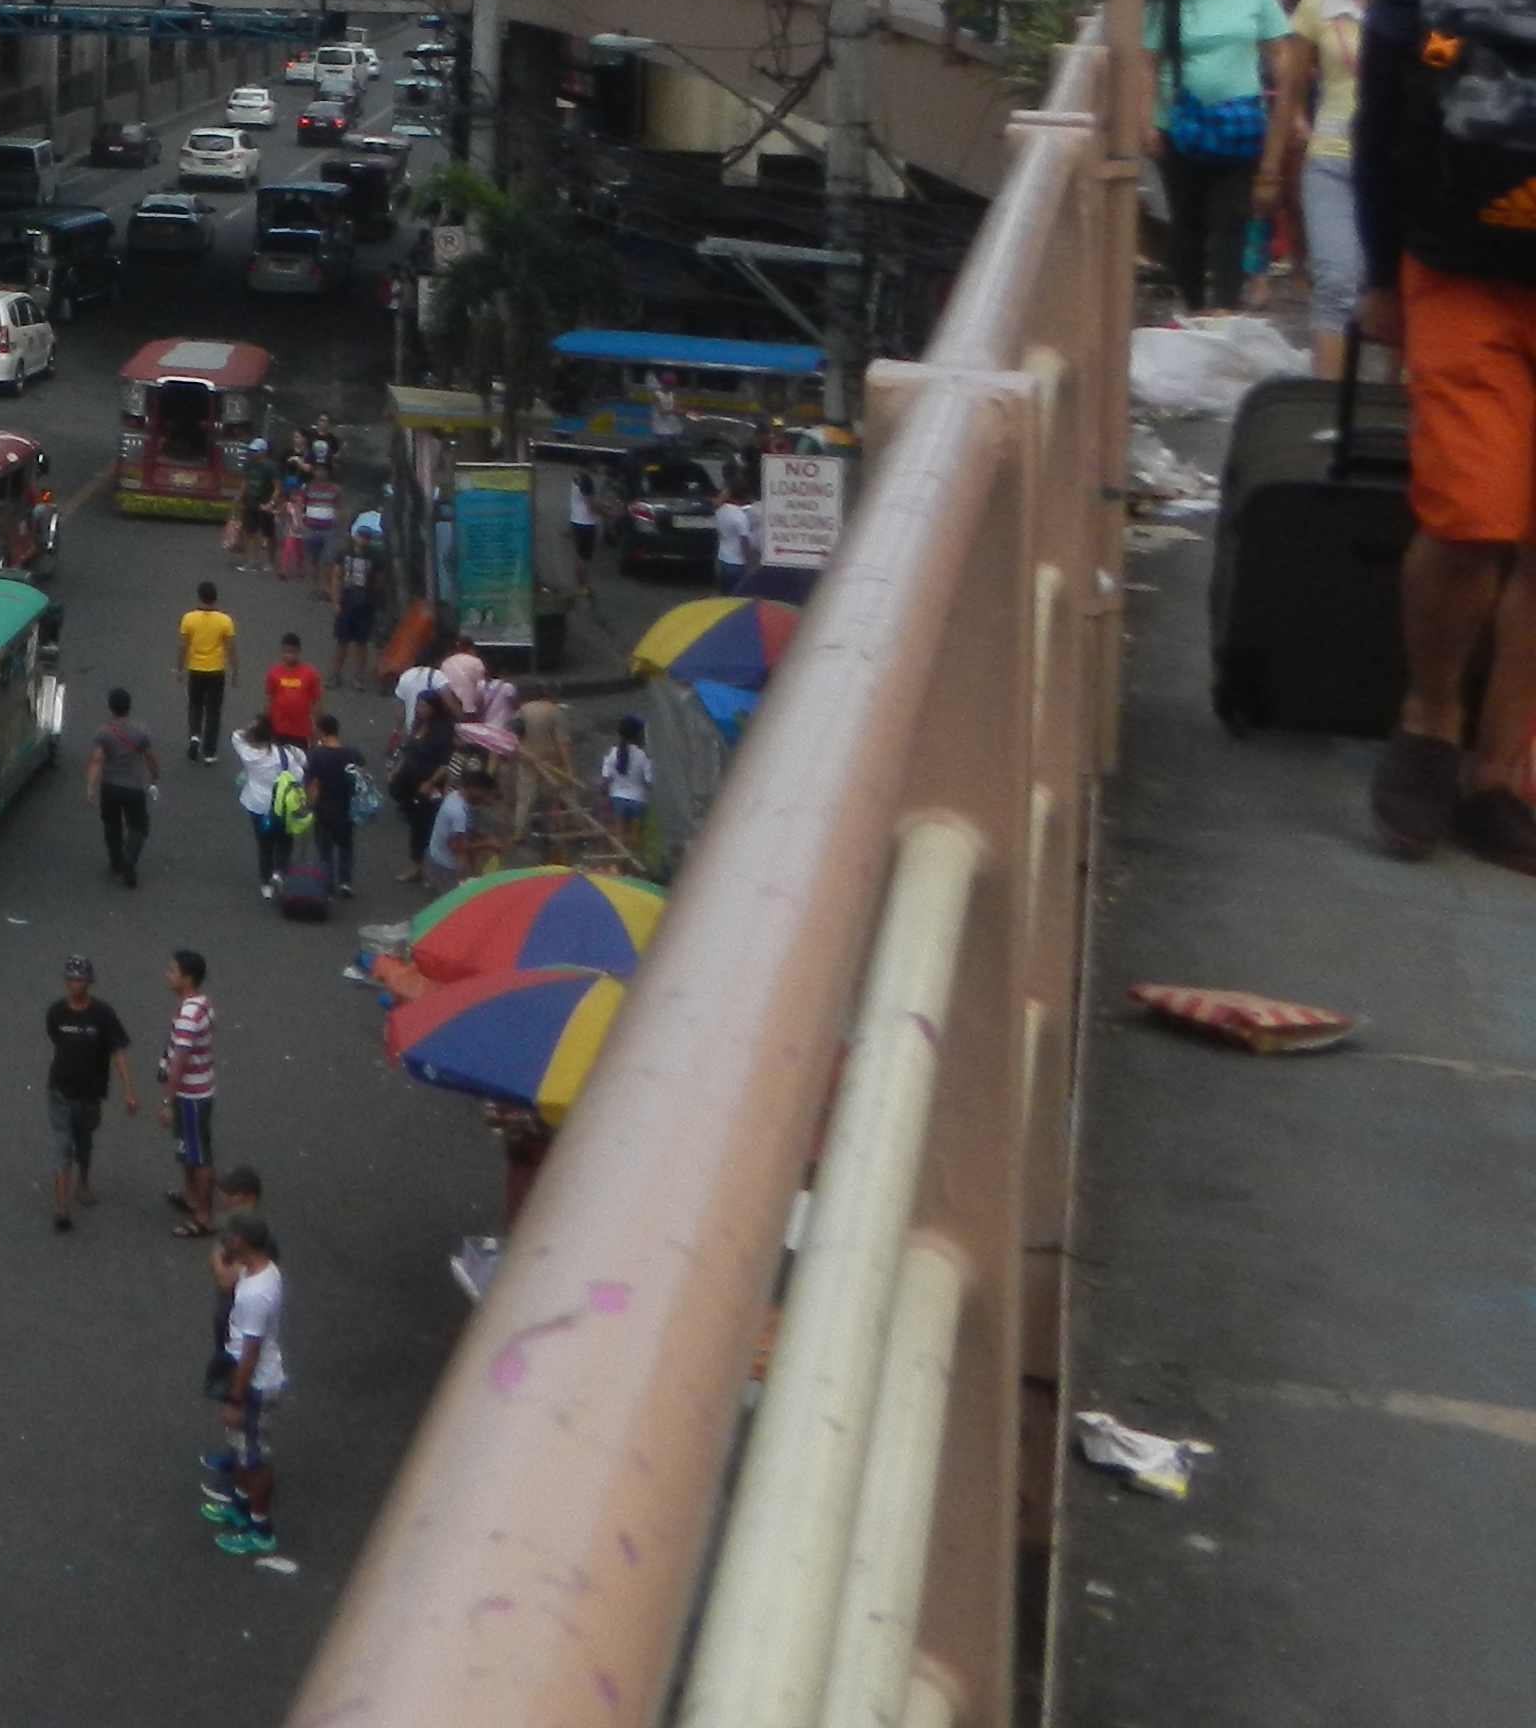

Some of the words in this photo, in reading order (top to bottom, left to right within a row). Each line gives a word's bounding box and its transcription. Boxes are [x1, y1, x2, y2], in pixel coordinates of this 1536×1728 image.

[785, 462, 820, 478] NO
[769, 479, 834, 498] LOADING
[785, 499, 819, 511] AND
